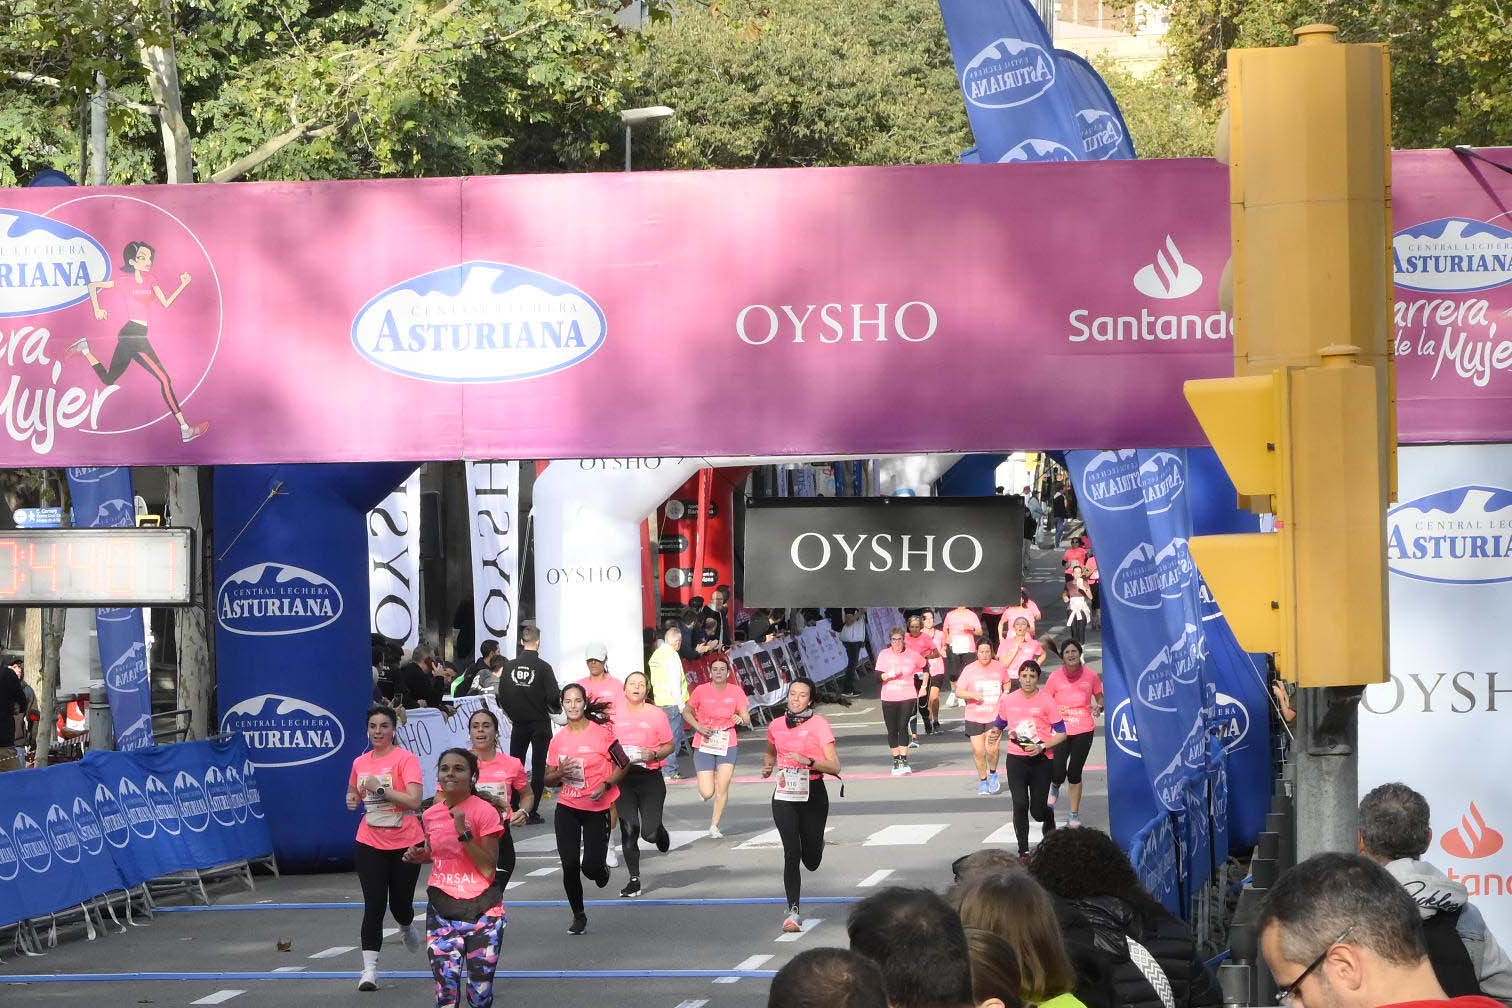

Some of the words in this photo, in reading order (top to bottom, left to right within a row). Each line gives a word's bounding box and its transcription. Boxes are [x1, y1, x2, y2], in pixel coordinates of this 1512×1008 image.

[14, 245, 87, 256] LECHERA
[1408, 243, 1460, 251] CENTRAL
[735, 301, 938, 345] OYSHO
[1068, 308, 1234, 344] Santand
[1394, 299, 1490, 328] arrera
[372, 309, 587, 352] ASTURIANA
[1417, 330, 1435, 356] la
[1431, 322, 1512, 387] Muje
[1415, 519, 1482, 530] CENTRAL
[790, 532, 983, 573] OYSHO
[547, 565, 622, 585] OYSHO
[221, 592, 334, 619] ASTURIANA
[233, 588, 276, 597] CENTRAL
[280, 587, 329, 596] LECHERA
[1360, 670, 1512, 715] OYSH
[235, 720, 277, 728] CENTRAL
[281, 719, 330, 727] LECHERA
